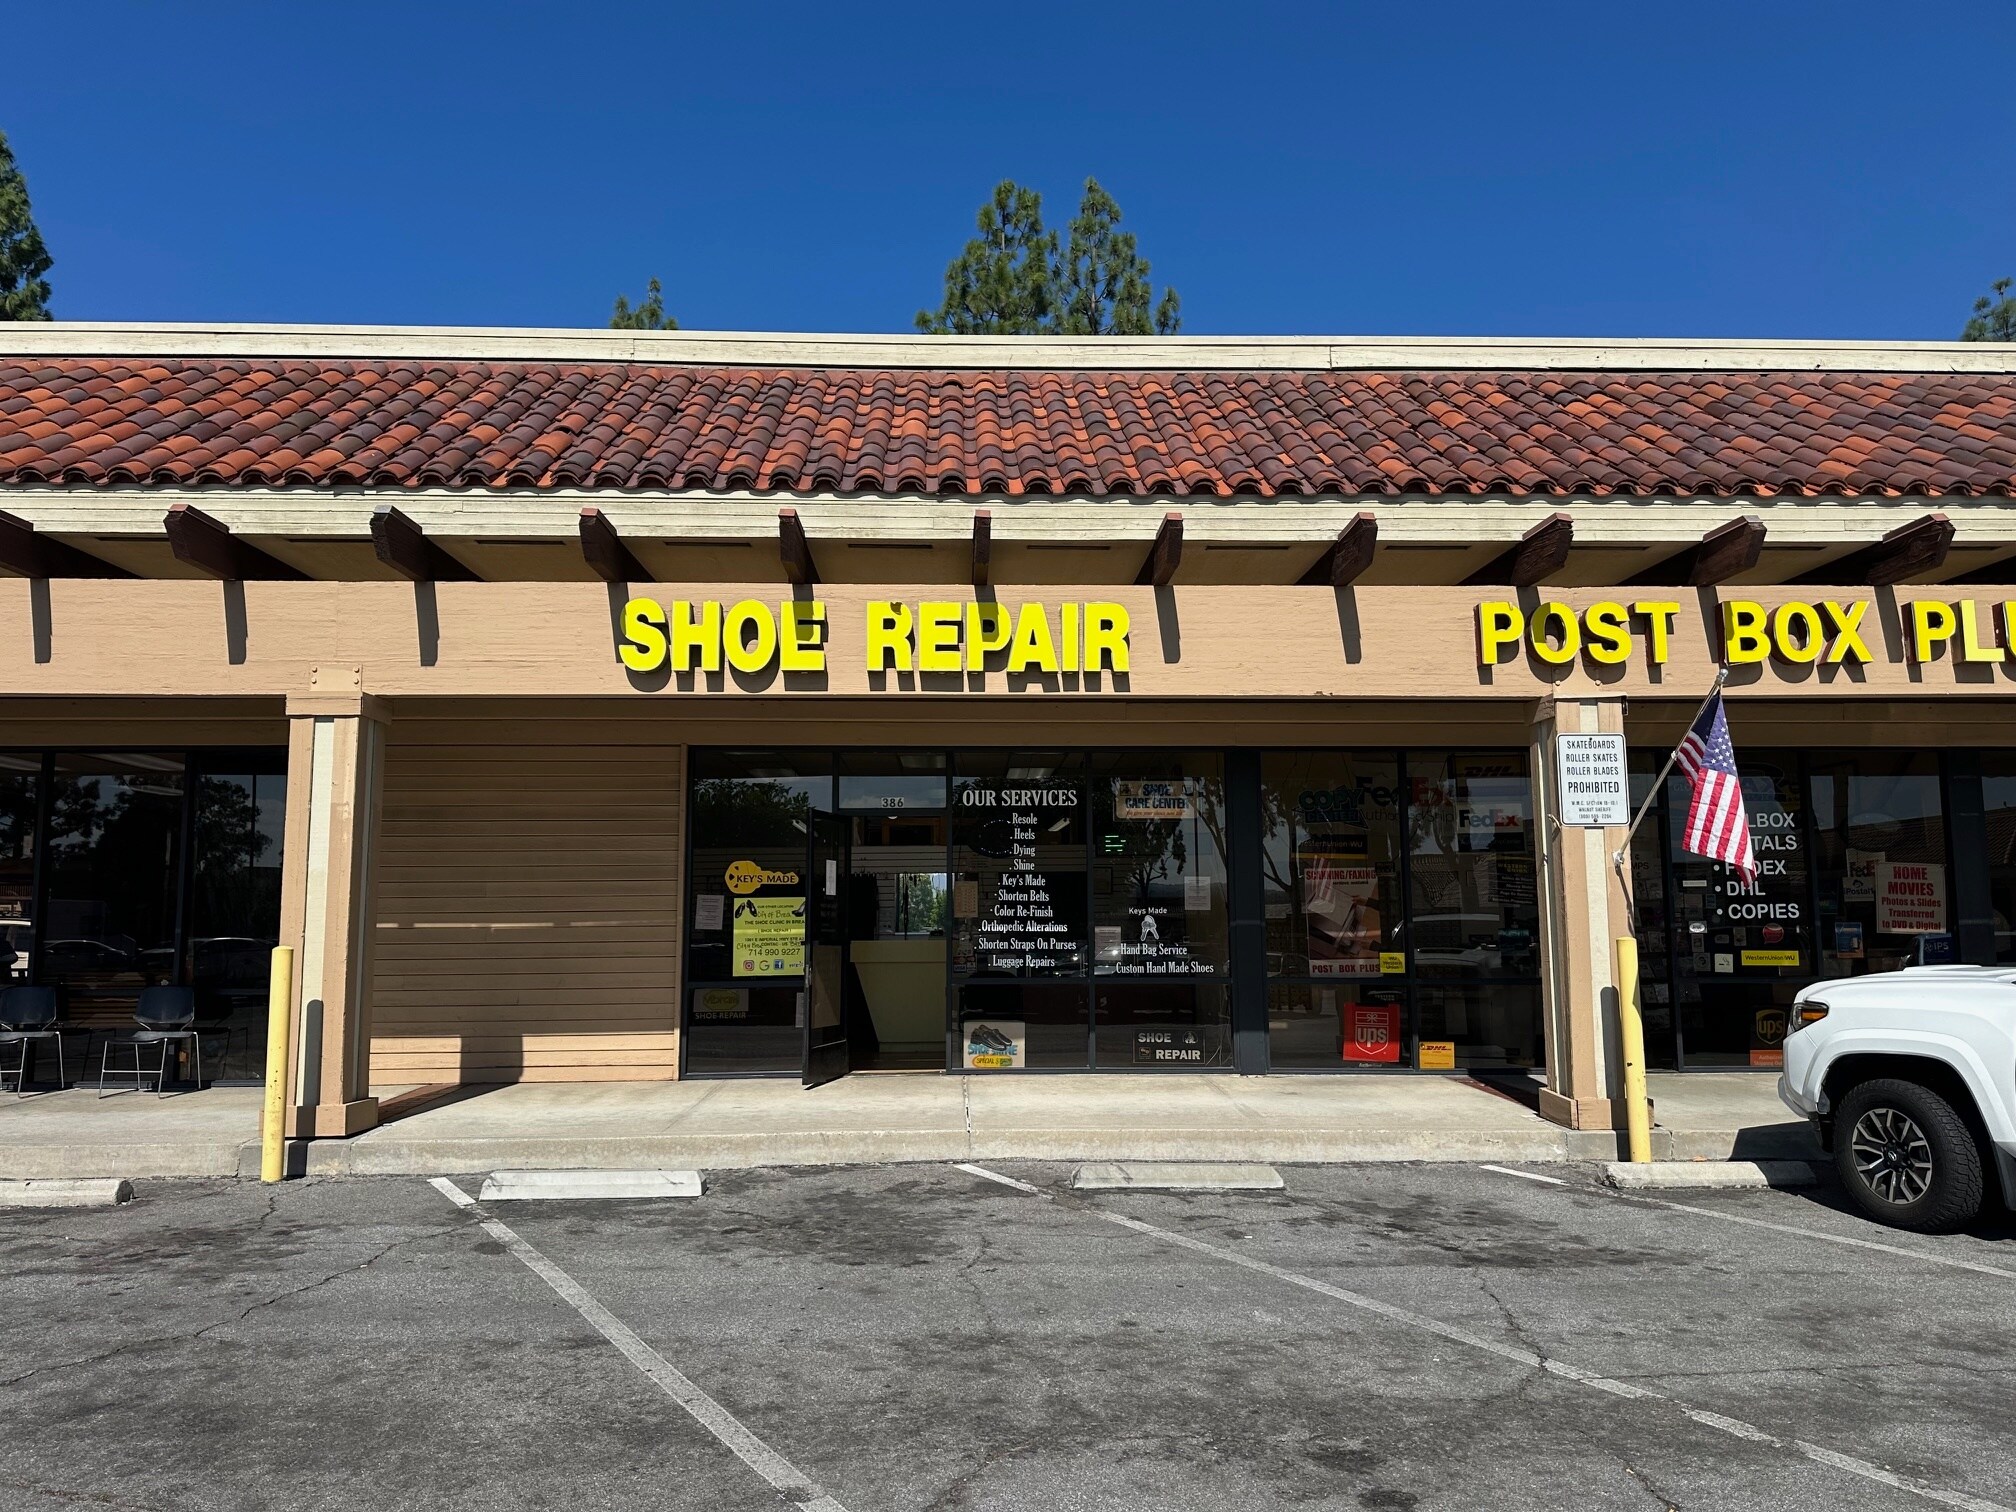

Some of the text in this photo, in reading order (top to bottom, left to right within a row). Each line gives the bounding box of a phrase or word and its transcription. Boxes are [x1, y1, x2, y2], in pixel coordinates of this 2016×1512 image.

[618, 598, 1130, 674] SHOE REPAIR
[1476, 600, 1680, 665] POST
[1717, 600, 1874, 664] BOX
[1566, 740, 1616, 750] SKATEBOARDS
[1566, 753, 1618, 762] ROLLER SKATES
[1566, 766, 1619, 776] ROLLER BLADES
[1568, 781, 1620, 794] PROHIBITED
[882, 797, 904, 808] 386
[962, 789, 1078, 807] OUR SERVICES
[1125, 798, 1190, 809] CARE CENTER
[1298, 788, 1364, 811] COPY
[1012, 812, 1038, 824] Resole
[1459, 809, 1520, 828] FedEx
[1747, 812, 1796, 828] LBOX
[1014, 828, 1036, 840] Heels
[1751, 835, 1798, 850] TALS
[1013, 843, 1036, 857] Dying
[1013, 859, 1035, 870] Shine
[736, 874, 796, 883] KEY'S MADE
[1306, 870, 1377, 880] SCANNING/FAXING
[1892, 866, 1928, 880] HOME
[1002, 874, 1046, 887] Key's Made
[1726, 880, 1766, 896] DHL
[1888, 882, 1934, 896] MOVIES
[998, 889, 1050, 902] Shorten Belts
[1881, 896, 1908, 906] Photos
[1917, 898, 1941, 907] Slides
[994, 904, 1053, 917] Color Re-Finish
[1128, 907, 1147, 915] Keys
[1728, 903, 1800, 920] COPIES
[1888, 909, 1934, 918] Transferred
[982, 920, 1068, 933] Orthopedic Alterations
[1916, 921, 1941, 930] Digital
[978, 937, 1076, 951] Shorten Straps On Purses
[1120, 943, 1188, 957] Hand Bag Service
[992, 954, 1055, 968] Luggage Repairs
[1116, 961, 1214, 974] Custom Hand Made Shoes
[1312, 965, 1380, 973] POST BOX PLUS
[1758, 1020, 1783, 1040] ups
[1138, 1033, 1172, 1043] SHOE
[1357, 1027, 1387, 1047] ups
[1155, 1049, 1201, 1060] REPAIR
